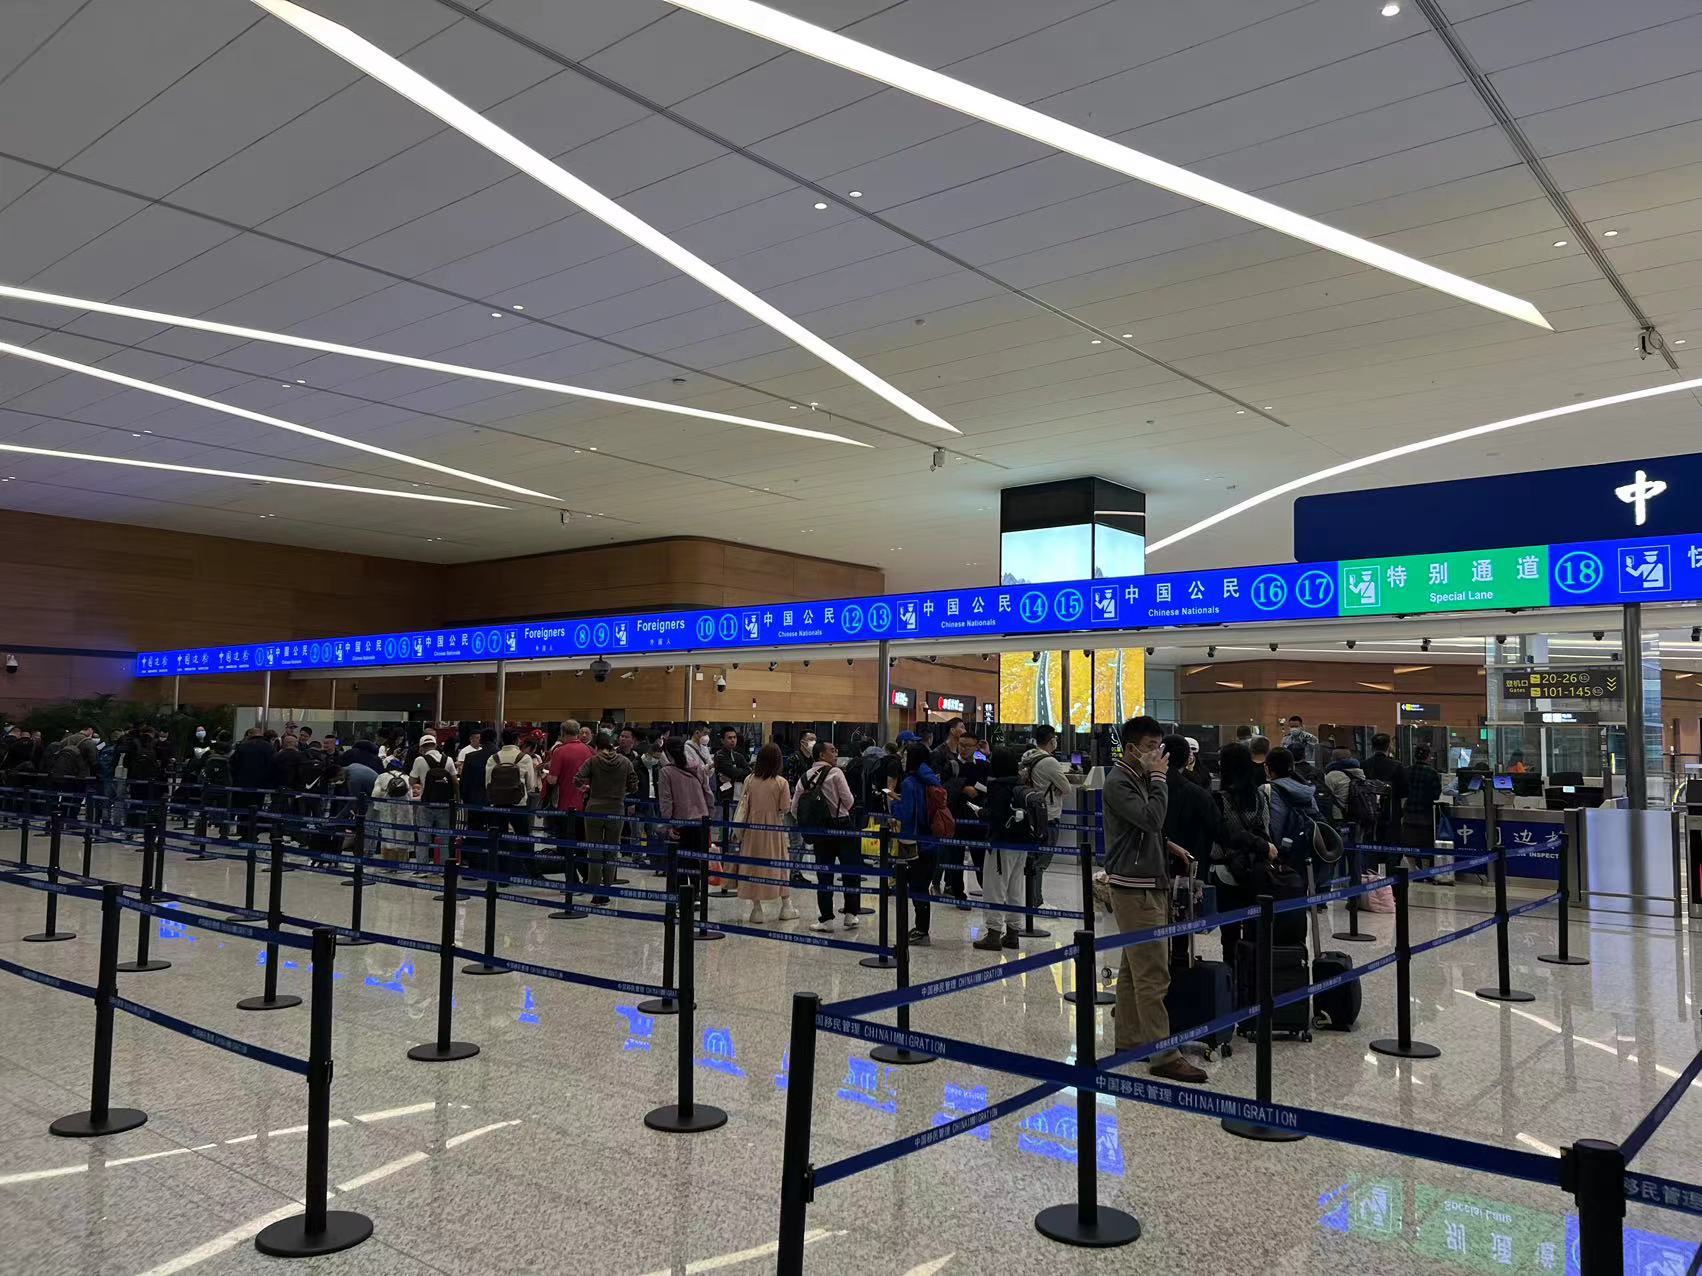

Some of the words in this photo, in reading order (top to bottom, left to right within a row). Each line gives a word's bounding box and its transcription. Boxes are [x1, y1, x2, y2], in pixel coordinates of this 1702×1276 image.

[1615, 470, 1667, 526] 中
[1386, 555, 1540, 588] 特别通道
[1125, 578, 1239, 604] 中国公民
[1429, 591, 1466, 604] Special
[1469, 591, 1493, 600] Lane
[923, 594, 1012, 616] 中国公民
[1148, 608, 1180, 617] Chinese
[1182, 605, 1220, 616] Nationals
[764, 607, 835, 627] 中国公民
[941, 620, 965, 629] Chinese
[967, 618, 996, 627] Nationals
[637, 619, 685, 633] Foreigners
[425, 633, 469, 648] 中国公民
[525, 627, 566, 640] Foreigners
[1542, 673, 1577, 683] 20-26
[1543, 687, 1591, 697] 101-145
[1096, 1076, 1172, 1102] 中国移民管理
